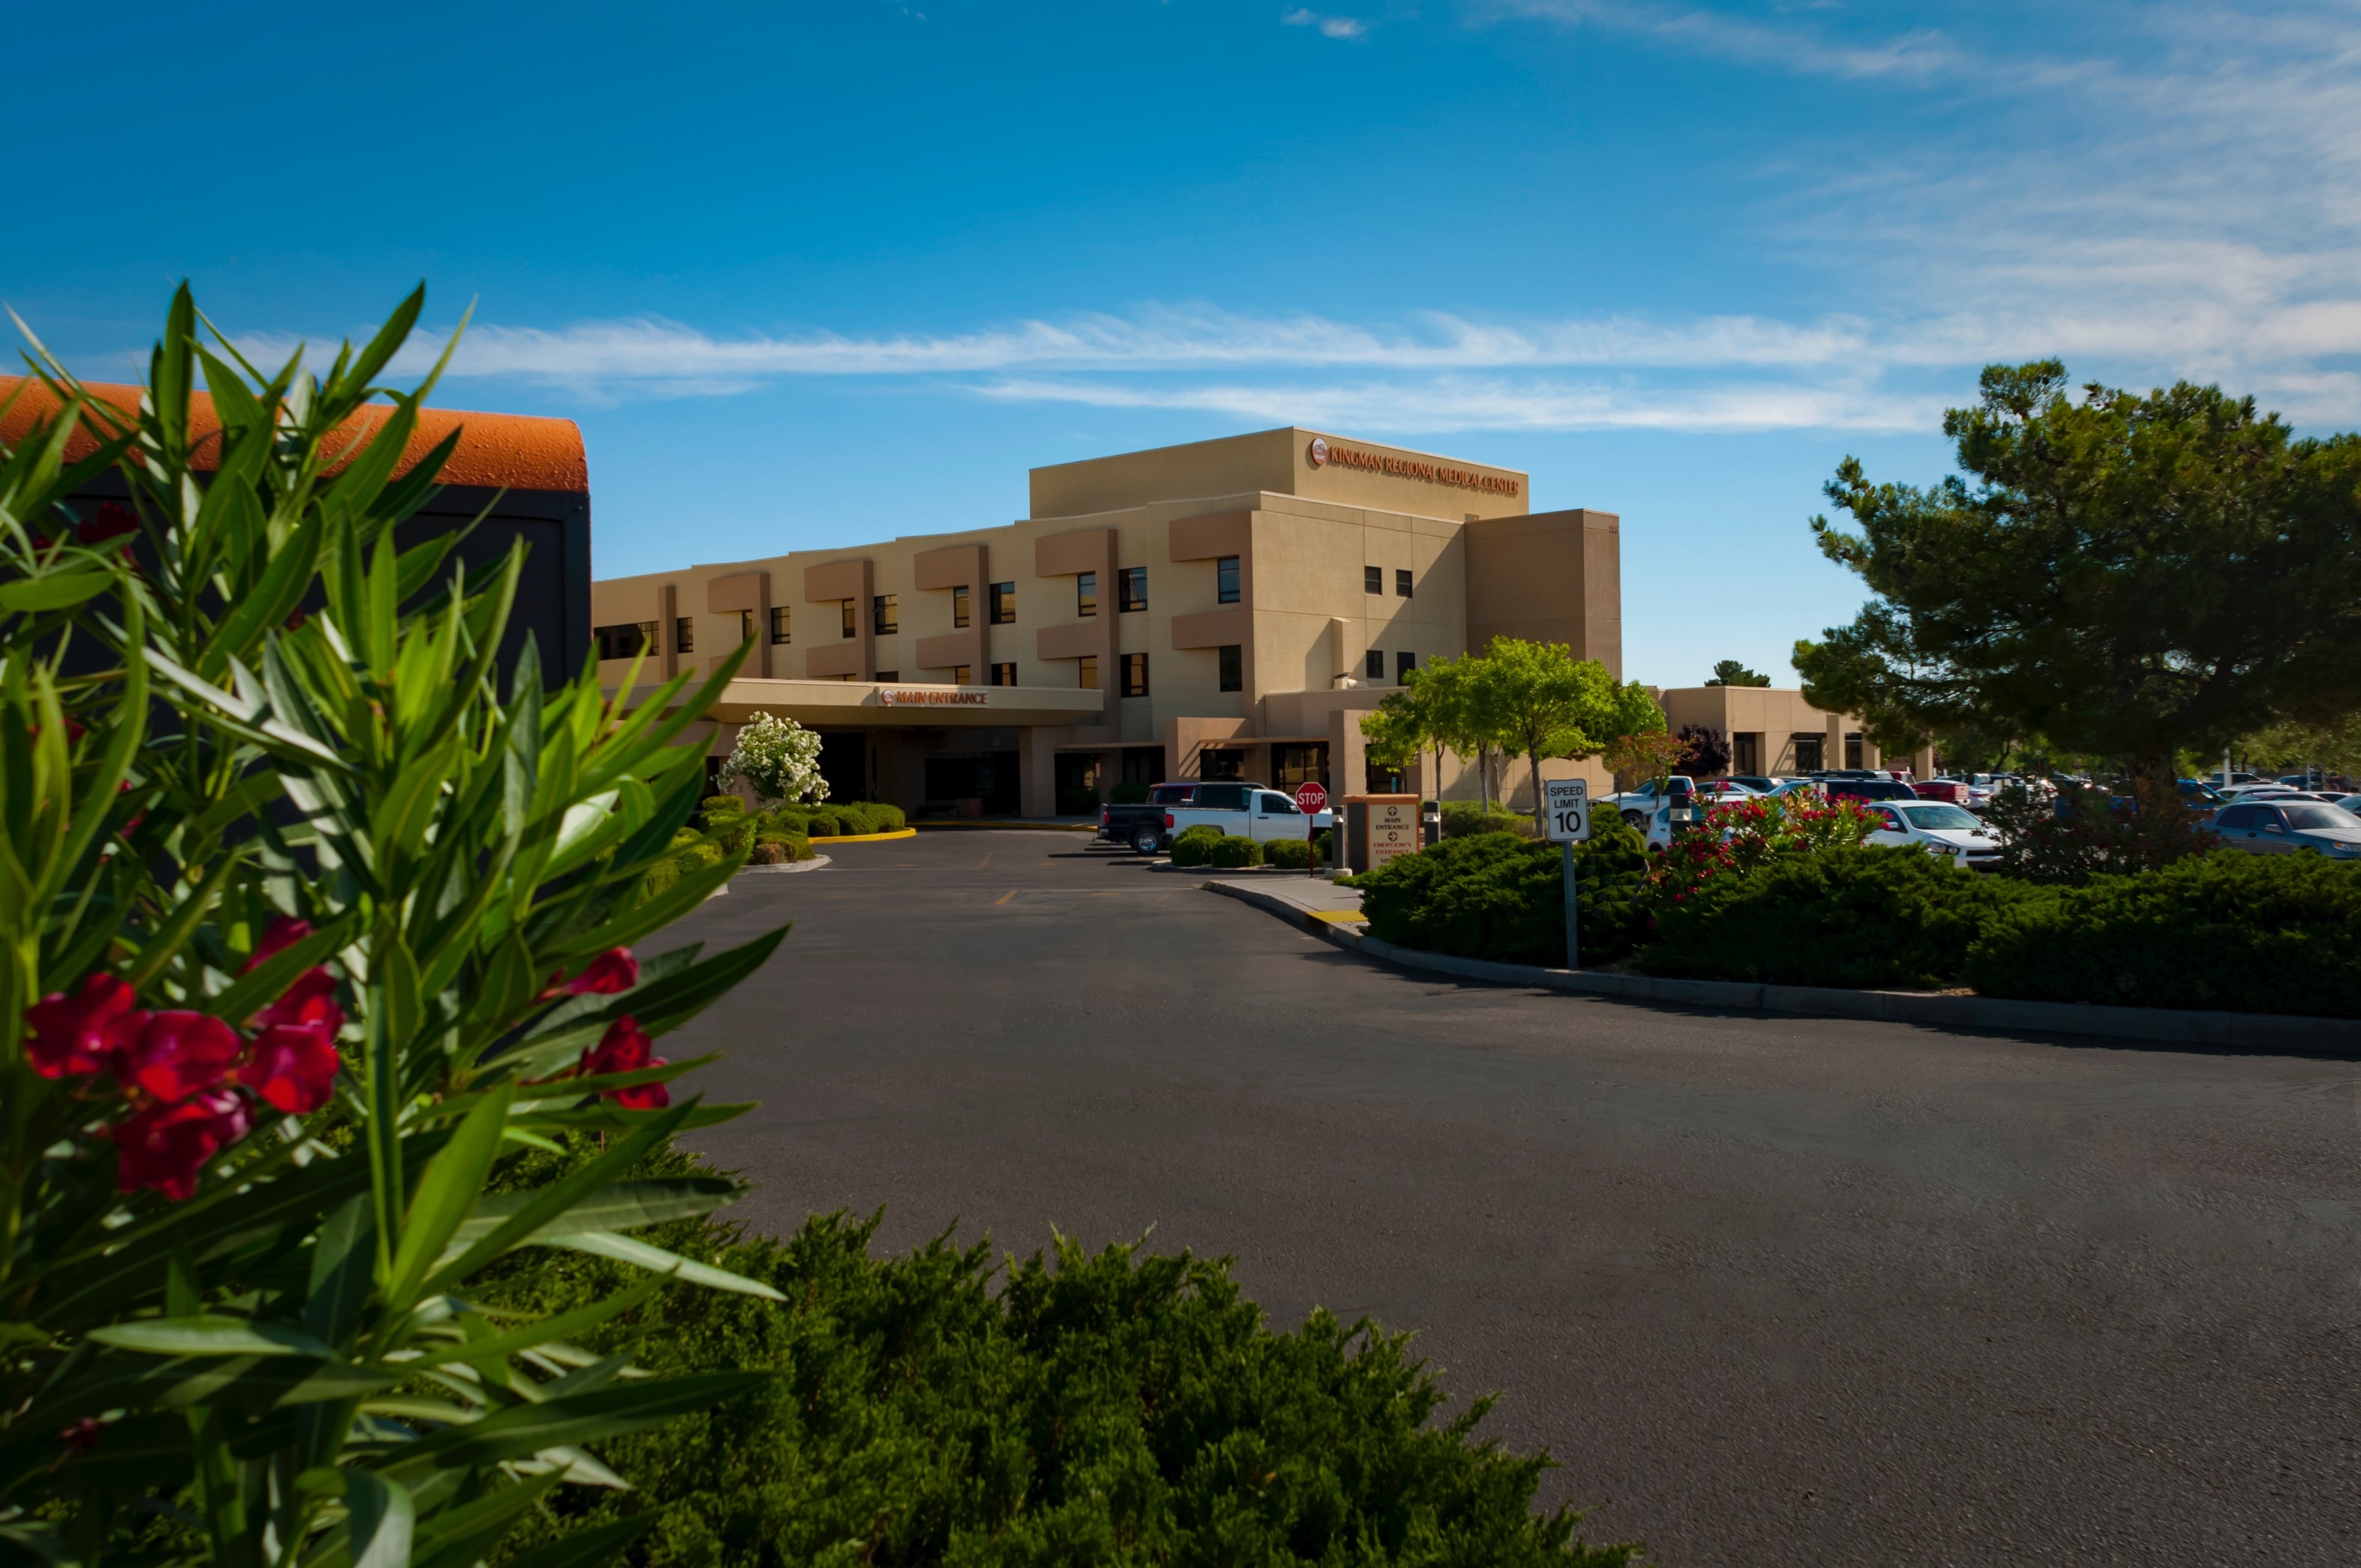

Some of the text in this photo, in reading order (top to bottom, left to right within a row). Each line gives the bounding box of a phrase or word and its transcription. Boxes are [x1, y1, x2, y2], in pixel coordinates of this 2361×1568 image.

[1330, 446, 1519, 495] KINGMAN REGIONAL MEDICAL CENTER
[897, 691, 987, 705] MAIN ENTRANCE
[1550, 786, 1583, 796] SPEED
[1299, 793, 1324, 805] STOP
[1554, 799, 1580, 809] LIMIT
[1555, 811, 1581, 832] 10
